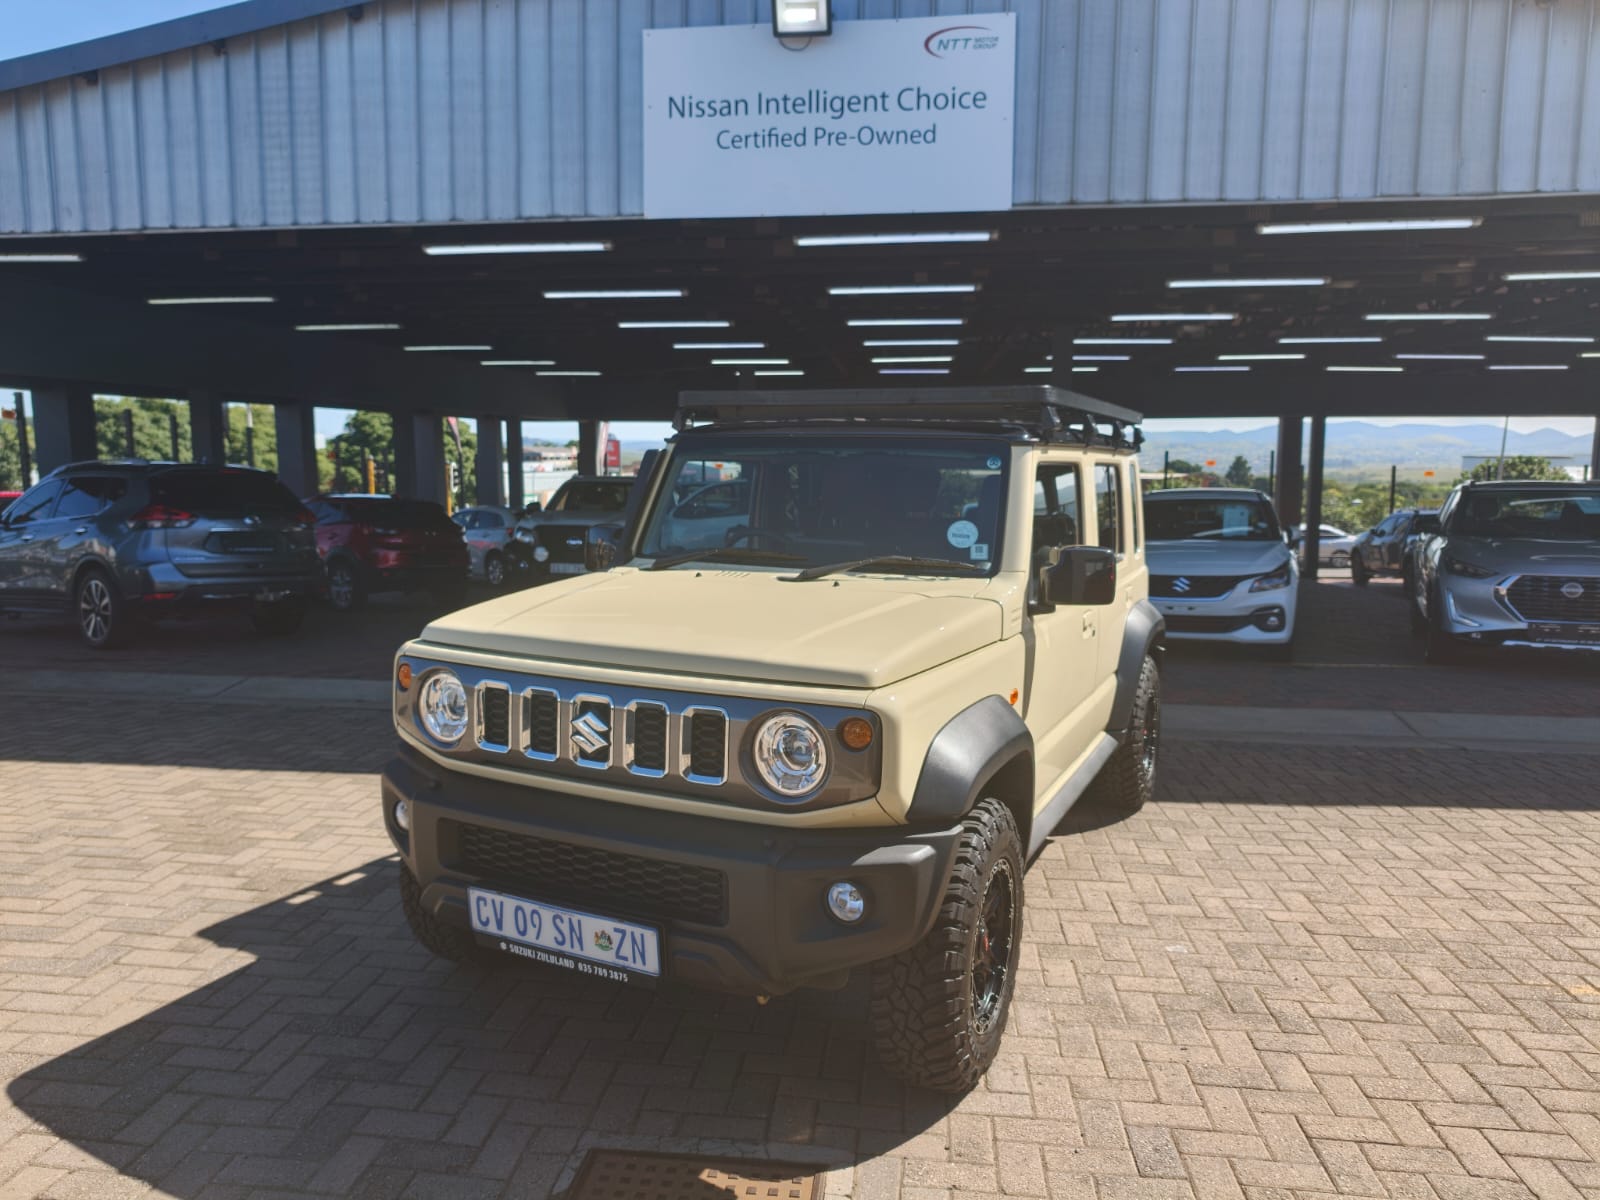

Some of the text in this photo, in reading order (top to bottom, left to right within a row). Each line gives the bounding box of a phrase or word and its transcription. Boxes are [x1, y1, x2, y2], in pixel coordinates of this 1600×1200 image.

[937, 37, 972, 51] NTT
[667, 86, 988, 120] Nissan Intelligent Choice
[716, 123, 937, 150] Certified Pre-Owned
[475, 895, 647, 966] CV 09 SN ZN
[509, 943, 536, 959] SUZUKI
[536, 951, 575, 969] ZULULAND
